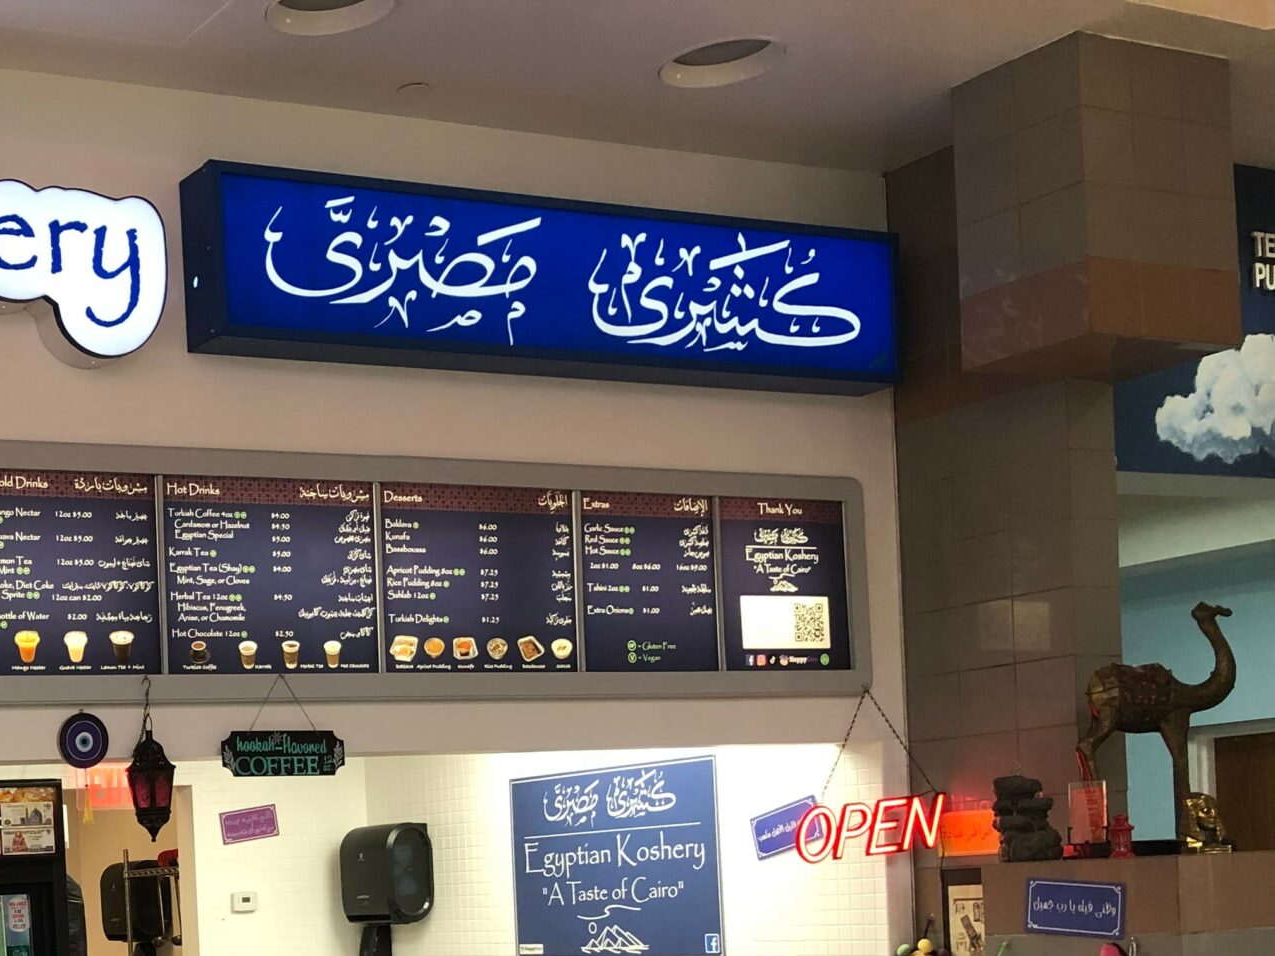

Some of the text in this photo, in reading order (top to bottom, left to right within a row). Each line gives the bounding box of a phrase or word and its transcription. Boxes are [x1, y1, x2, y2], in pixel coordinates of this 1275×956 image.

[15, 475, 49, 490] Drinks
[166, 482, 220, 497] Hot Drinks
[383, 490, 423, 503] Desserts
[583, 497, 610, 510] Extras
[756, 502, 803, 516] Thank You
[15, 507, 41, 517] Nectar
[167, 508, 220, 518] Turkish Coffee
[15, 531, 41, 541] Nectar
[584, 534, 619, 544] Red Sauce
[168, 546, 193, 557] Karrak
[745, 548, 819, 565] Egyptian Koshery
[15, 555, 33, 565] Tea
[386, 565, 441, 578] Apricot Pudding
[764, 564, 783, 574] Taste
[15, 580, 55, 590] Diet Coke
[387, 578, 430, 590] Rice Pudding
[1, 590, 26, 601] Sprite
[170, 591, 211, 601] Herbal Tea
[18, 610, 27, 620] of
[26, 612, 50, 621] Water
[388, 614, 415, 624] Turkish
[171, 628, 223, 639] Hot Chocolate
[642, 641, 677, 651] Gluten Free
[642, 653, 661, 663] Vegan
[234, 755, 320, 776] COFFEE
[795, 791, 946, 864] OPEN
[524, 830, 706, 879] Egyptian Koshery
[542, 876, 685, 906] "A Taste of Cairo"
